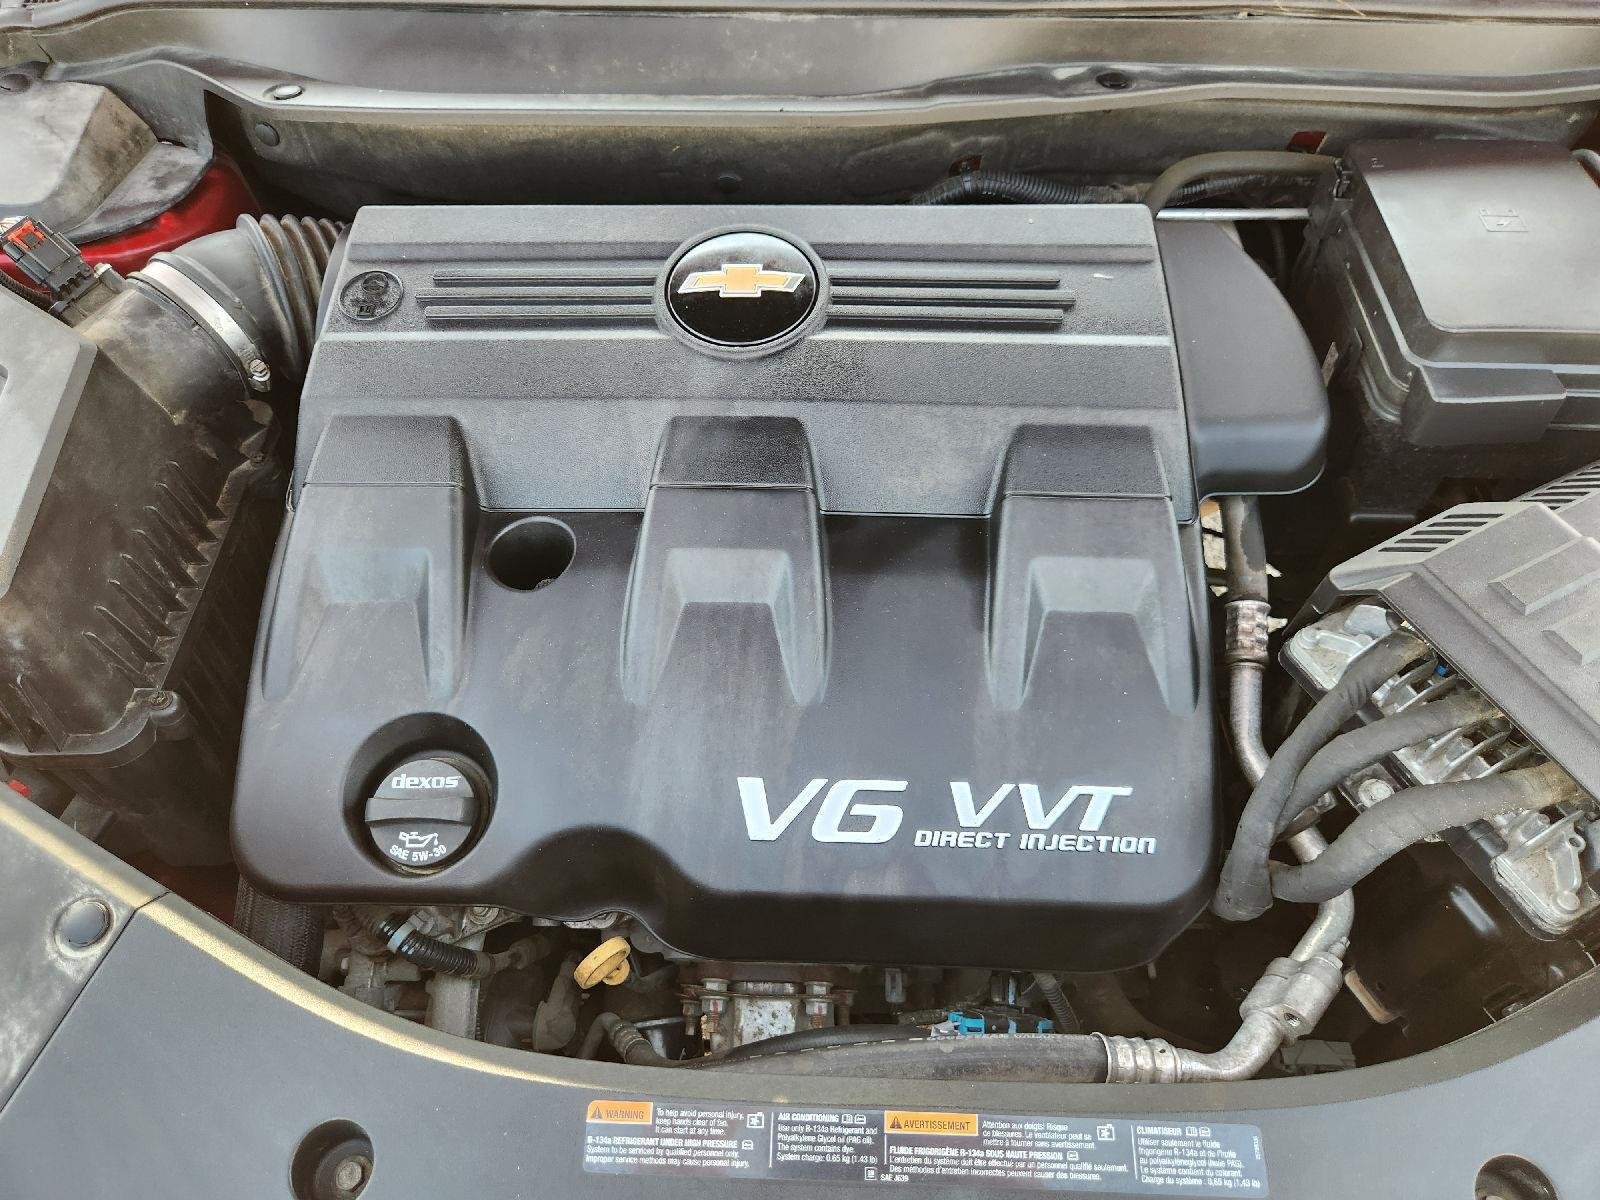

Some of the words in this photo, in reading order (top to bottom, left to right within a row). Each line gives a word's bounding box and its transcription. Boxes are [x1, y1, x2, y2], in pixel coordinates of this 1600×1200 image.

[391, 774, 460, 789] dexos
[737, 776, 908, 844] V6
[949, 781, 1134, 832] VVT
[913, 829, 1011, 850] DIRECT
[1019, 832, 1157, 856] INJECTION
[389, 844, 410, 861] SAE
[411, 844, 447, 861] 5W-30
[606, 1109, 645, 1120] WARNING
[656, 1108, 663, 1117] To
[665, 1108, 679, 1118] help
[680, 1109, 697, 1117] avoid
[698, 1110, 725, 1119] personal
[778, 1112, 790, 1121] AIR
[791, 1113, 840, 1123] CONDITIONING
[656, 1118, 671, 1127] keep
[672, 1118, 691, 1126] hands
[693, 1118, 708, 1126] clear
[904, 1120, 971, 1131] AVERTISSEMENT
[982, 1120, 1011, 1130] Attention
[1046, 1122, 1069, 1132] Risque
[655, 1125, 661, 1133] It
[661, 1126, 673, 1134] can
[673, 1126, 689, 1134] start
[697, 1127, 708, 1136] any
[778, 1124, 790, 1132] Use
[791, 1124, 804, 1133] only
[805, 1124, 829, 1133] R-134a
[829, 1126, 864, 1135] Refrigerant
[865, 1127, 878, 1135] and
[1136, 1125, 1182, 1136] CLIMATISEUR
[777, 1133, 816, 1143] Polyalkylene
[817, 1134, 837, 1144] Glycol
[1034, 1131, 1067, 1140] ventilateur
[1068, 1133, 1083, 1141] peut
[587, 1136, 612, 1145] R-134a
[612, 1136, 660, 1146] REFRIGERANT
[660, 1138, 684, 1147] UNDER
[684, 1139, 702, 1147] HIGH
[702, 1139, 738, 1149] PRESSURE
[777, 1142, 790, 1151] The
[790, 1143, 813, 1152] system
[814, 1144, 841, 1153] contains
[983, 1138, 1004, 1146] mettre
[1010, 1139, 1034, 1148] tourner
[1137, 1136, 1160, 1146] Utiliser
[1160, 1138, 1194, 1148] seulement
[1202, 1139, 1221, 1149] fluide
[586, 1145, 610, 1154] System
[611, 1146, 618, 1154] to
[619, 1146, 628, 1154] be
[628, 1146, 655, 1155] serviced
[656, 1147, 664, 1156] by
[665, 1147, 692, 1157] qualified
[693, 1149, 724, 1157] personnel
[889, 1146, 914, 1155] FLUIDE
[914, 1146, 960, 1156] FRIGORIGÈNE
[960, 1148, 985, 1158] R-134a
[985, 1149, 1005, 1158] SOUS
[1005, 1150, 1028, 1159] HAUTE
[1028, 1151, 1063, 1161] PRESSION
[1173, 1147, 1199, 1157] R-134a
[1199, 1149, 1206, 1157] et
[1207, 1149, 1216, 1158] de
[586, 1154, 614, 1164] Improper
[615, 1155, 638, 1163] service
[639, 1156, 667, 1164] methods
[667, 1157, 681, 1166] may
[702, 1159, 730, 1167] personal
[776, 1152, 801, 1162] System
[801, 1153, 825, 1162] charge:
[826, 1154, 841, 1163] 0.65
[841, 1155, 851, 1164] kg
[923, 1156, 932, 1164] du
[933, 1157, 960, 1167] système
[960, 1158, 973, 1166] doit
[974, 1158, 987, 1167] être
[1015, 1161, 1026, 1169] par
[1036, 1161, 1068, 1169] personnel
[889, 1164, 903, 1173] Des
[903, 1166, 935, 1174] méthodes
[970, 1167, 1006, 1177] incorrectes
[1006, 1170, 1033, 1178] peuvent
[1056, 1170, 1069, 1179] des
[1140, 1165, 1149, 1174] Le
[1205, 1168, 1214, 1176] du
[880, 1173, 893, 1181] SAE
[1141, 1174, 1165, 1185] Charge
[1165, 1175, 1174, 1184] du
[1223, 1178, 1233, 1188] kg
